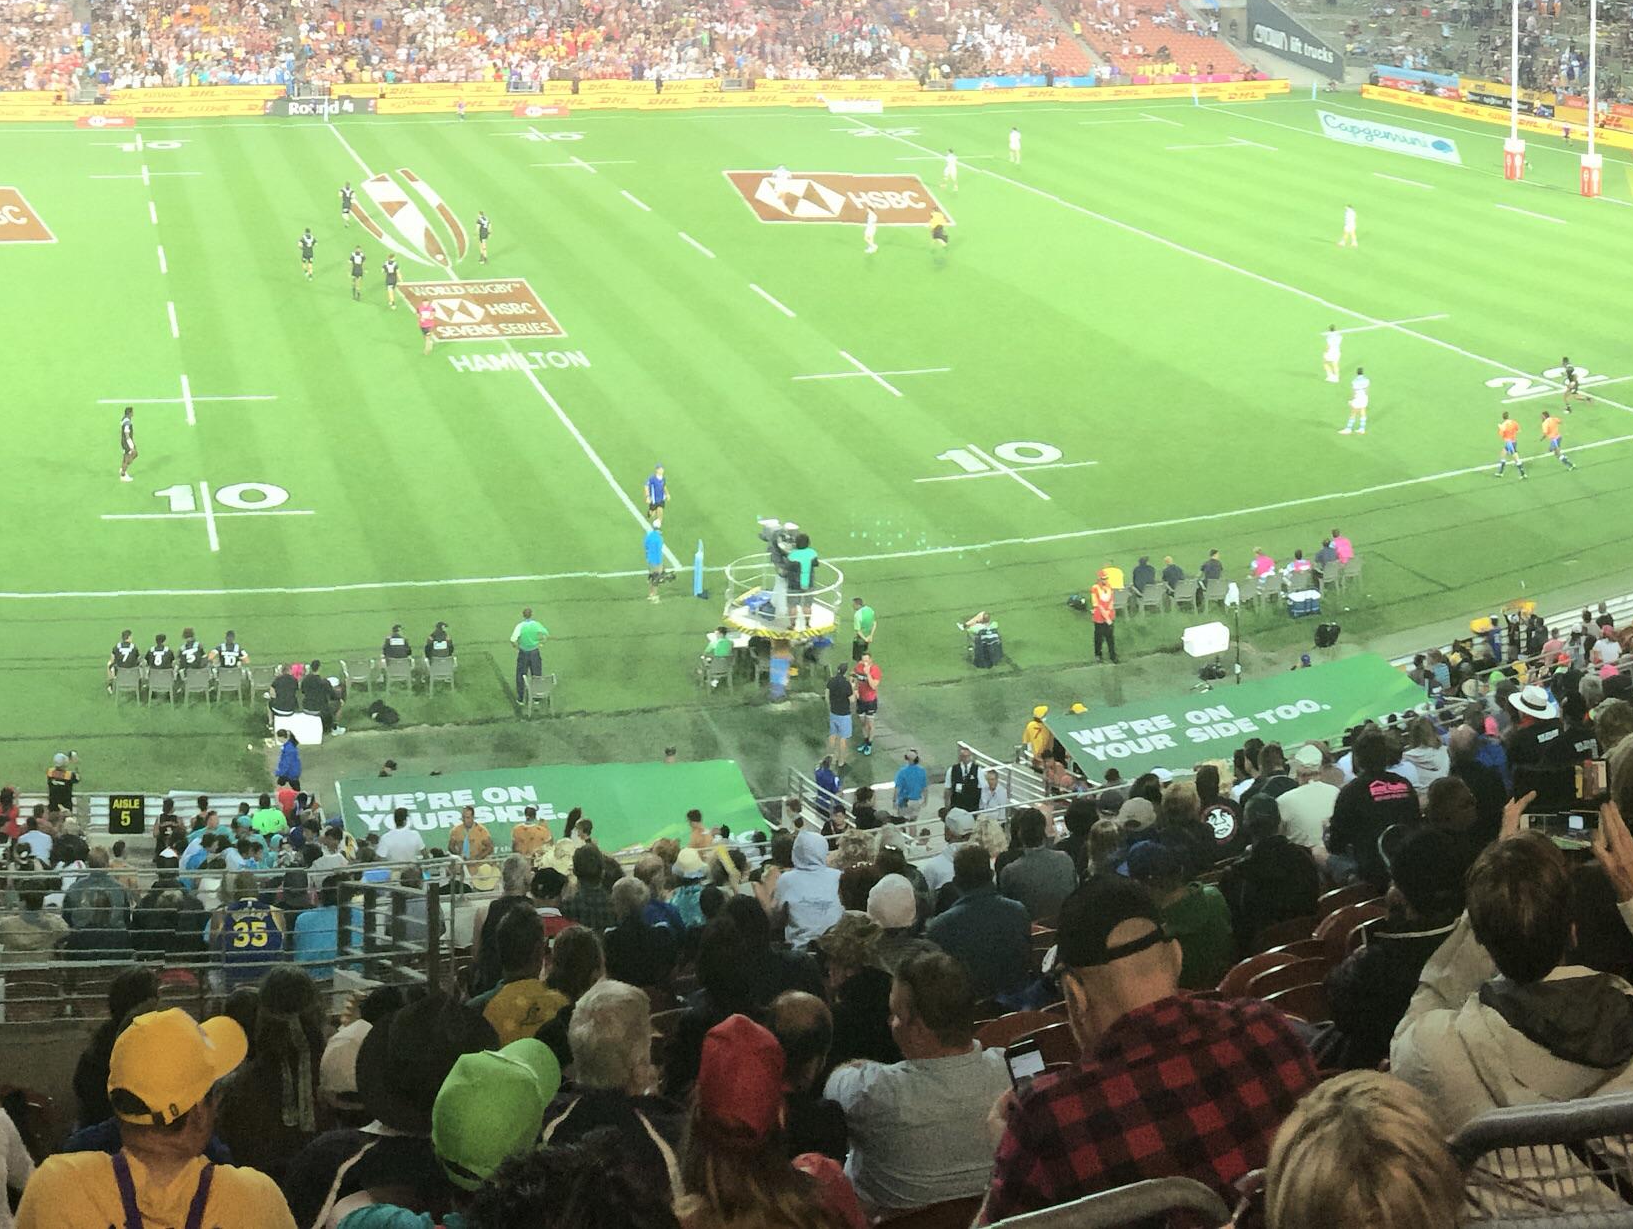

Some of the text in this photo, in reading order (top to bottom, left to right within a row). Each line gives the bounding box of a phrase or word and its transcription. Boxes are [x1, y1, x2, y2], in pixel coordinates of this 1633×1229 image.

[1304, 42, 1334, 64] trucks
[288, 98, 340, 115] Round
[1323, 113, 1431, 148] Capgemini
[846, 189, 928, 211] HSBC
[409, 285, 465, 296] WORLD
[484, 302, 537, 316] HSBC
[435, 321, 554, 338] SEVENS SERIES
[447, 350, 591, 373] HAMILTON
[935, 440, 1065, 473] 10
[152, 481, 292, 512] 10
[1034, 726, 1042, 739] 7
[1068, 704, 1235, 747] WE'RE ON
[1080, 698, 1332, 762] YOUR SIDE TOO.
[113, 798, 141, 810] AISLE
[353, 785, 538, 812] WE'RE ON
[120, 810, 131, 827] 5
[232, 920, 269, 949] 35
